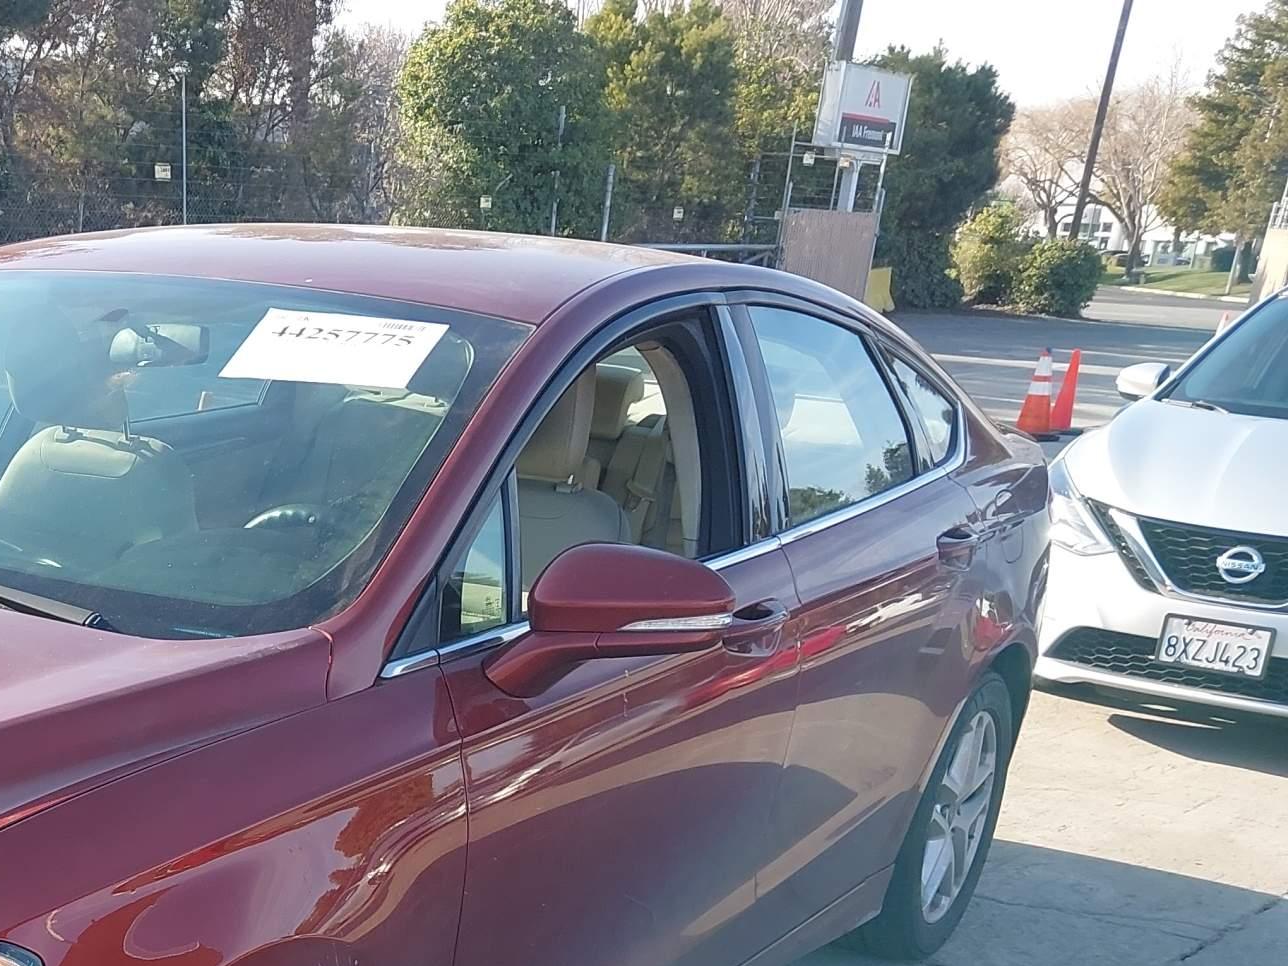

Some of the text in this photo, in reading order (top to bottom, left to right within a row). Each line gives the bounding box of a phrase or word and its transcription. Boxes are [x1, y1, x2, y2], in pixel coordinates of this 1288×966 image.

[272, 325, 416, 347] 44257775
[1222, 560, 1259, 571] NISSAN
[1186, 623, 1250, 640] California
[1165, 635, 1260, 670] 8XZJ423
